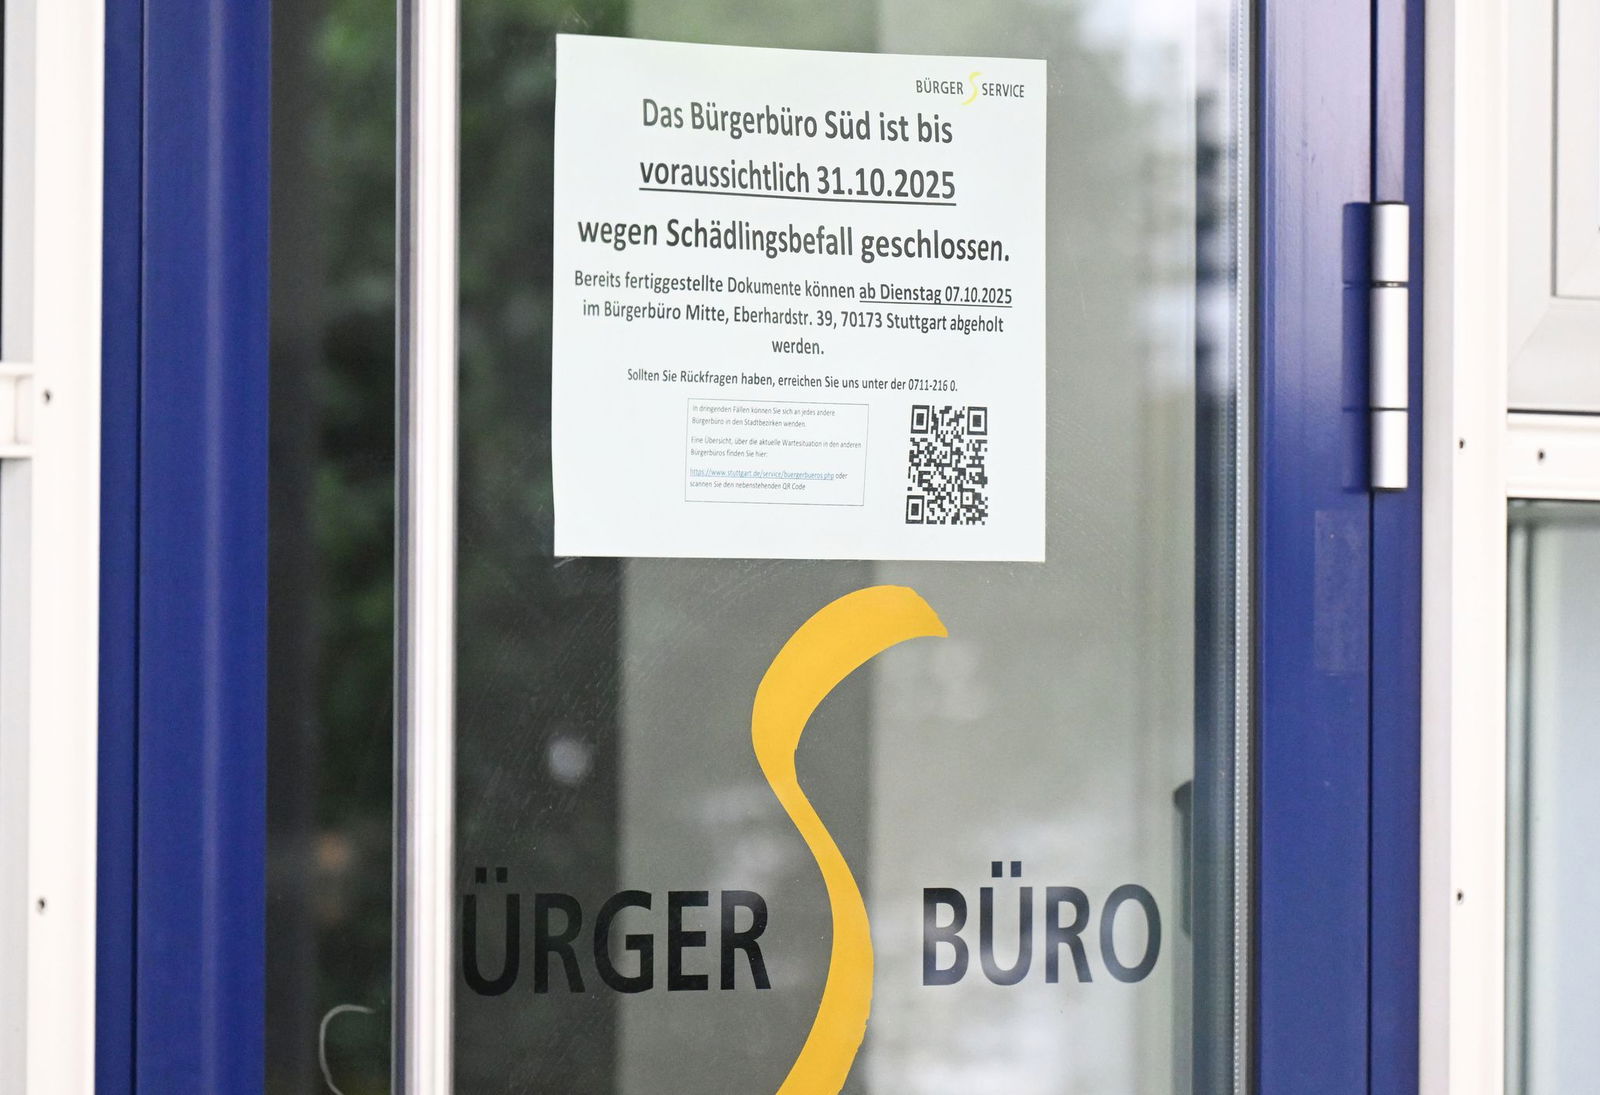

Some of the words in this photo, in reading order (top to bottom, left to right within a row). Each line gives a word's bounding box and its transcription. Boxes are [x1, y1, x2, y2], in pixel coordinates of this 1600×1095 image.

[916, 78, 963, 94] BÜRGER
[982, 83, 1024, 97] SERVICE
[643, 99, 683, 128] Das
[691, 102, 817, 139] Bürgerbüro
[825, 111, 870, 140] Süd
[880, 112, 909, 141] ist
[918, 113, 952, 143] bis
[640, 159, 809, 193] voraussichtlich
[816, 166, 955, 200] 31.10.2025
[578, 222, 657, 251] wegen
[666, 218, 852, 259] Schädlingsbefall
[861, 229, 1009, 263] geschlossen.
[575, 270, 620, 287] Bereits
[625, 272, 723, 294] fertiggestellte
[728, 277, 801, 296] Dokumente
[805, 280, 855, 298] können
[859, 284, 877, 302] ab
[879, 284, 942, 305] Dienstag
[945, 286, 1012, 306] 07.10.2025
[584, 300, 599, 316] im
[605, 301, 681, 321] Bürgerbüro
[686, 304, 729, 324] Mitte,
[734, 306, 812, 325] Eberhardstr.
[817, 310, 836, 329] 39,
[841, 311, 882, 328] 70173
[887, 313, 947, 334] Stuttgart
[950, 314, 1003, 335] abgeholt
[772, 337, 824, 354] werden.
[628, 369, 659, 381] Sollten
[663, 370, 677, 382] Sie
[681, 371, 737, 387] Rückfragen
[741, 372, 775, 387] haben,
[778, 375, 822, 387] erreichen
[825, 376, 839, 388] Sie
[842, 380, 859, 388] uns
[862, 378, 888, 389] unter
[891, 378, 906, 390] der
[908, 379, 948, 391] 0711-216
[950, 380, 957, 391] 0.
[699, 405, 731, 414] dringenden
[733, 405, 750, 414] Fällen
[692, 418, 724, 426] Bürgerbüro
[691, 436, 703, 444] Eine
[705, 437, 732, 445] Übersicht,
[734, 437, 747, 445] über
[782, 439, 822, 447] Wartesituation
[691, 449, 725, 457] Bürgerbüros
[462, 867, 772, 996] ÜRGER
[922, 861, 1162, 987] BÜRO
